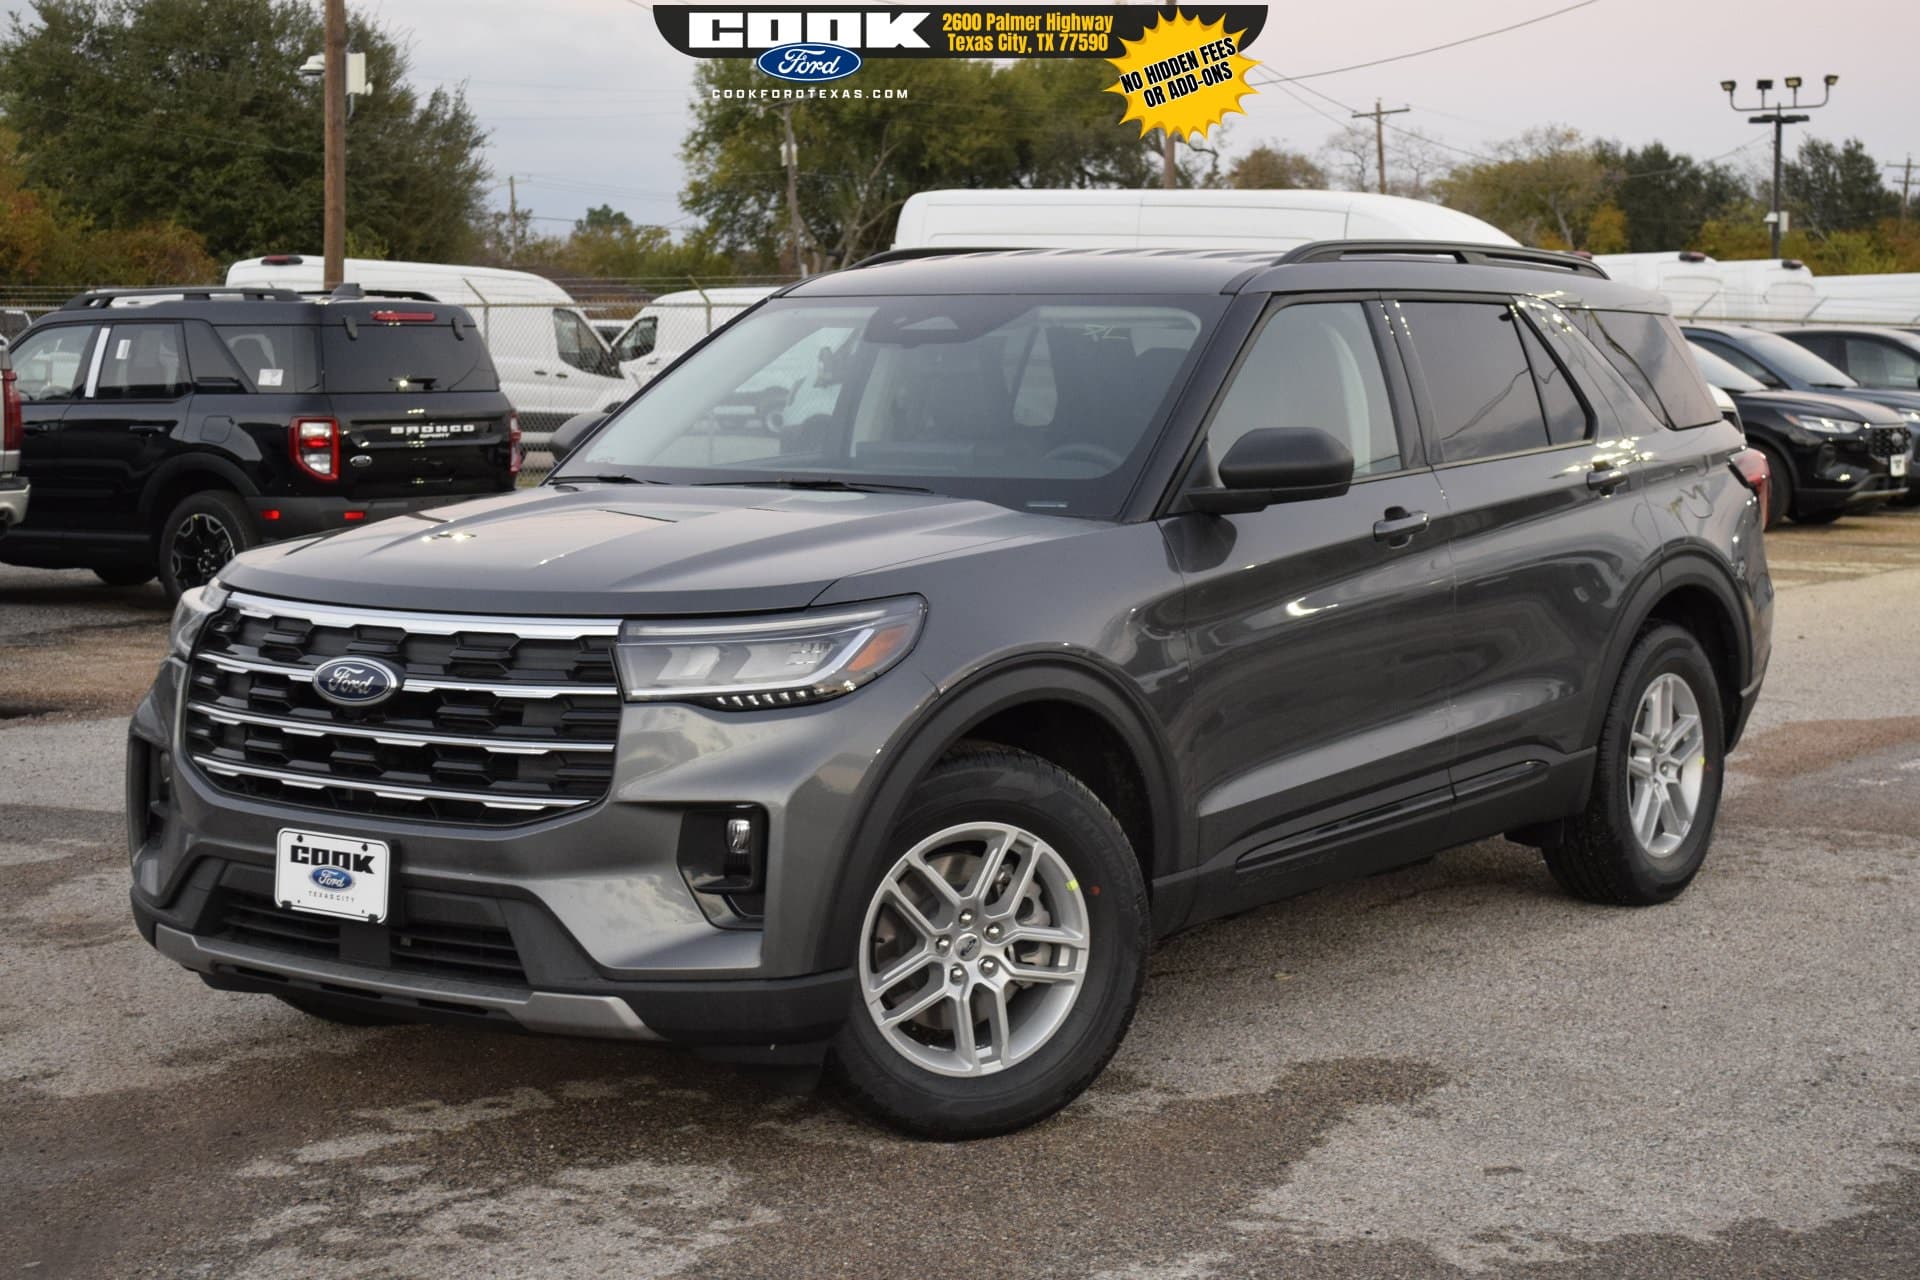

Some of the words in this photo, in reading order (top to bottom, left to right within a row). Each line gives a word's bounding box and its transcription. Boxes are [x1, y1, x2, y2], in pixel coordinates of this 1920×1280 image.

[390, 425, 475, 435] BRONCO
[328, 666, 375, 694] Ford
[290, 844, 375, 875] COOK
[318, 869, 345, 888] Ford
[308, 890, 334, 900] TEXAS
